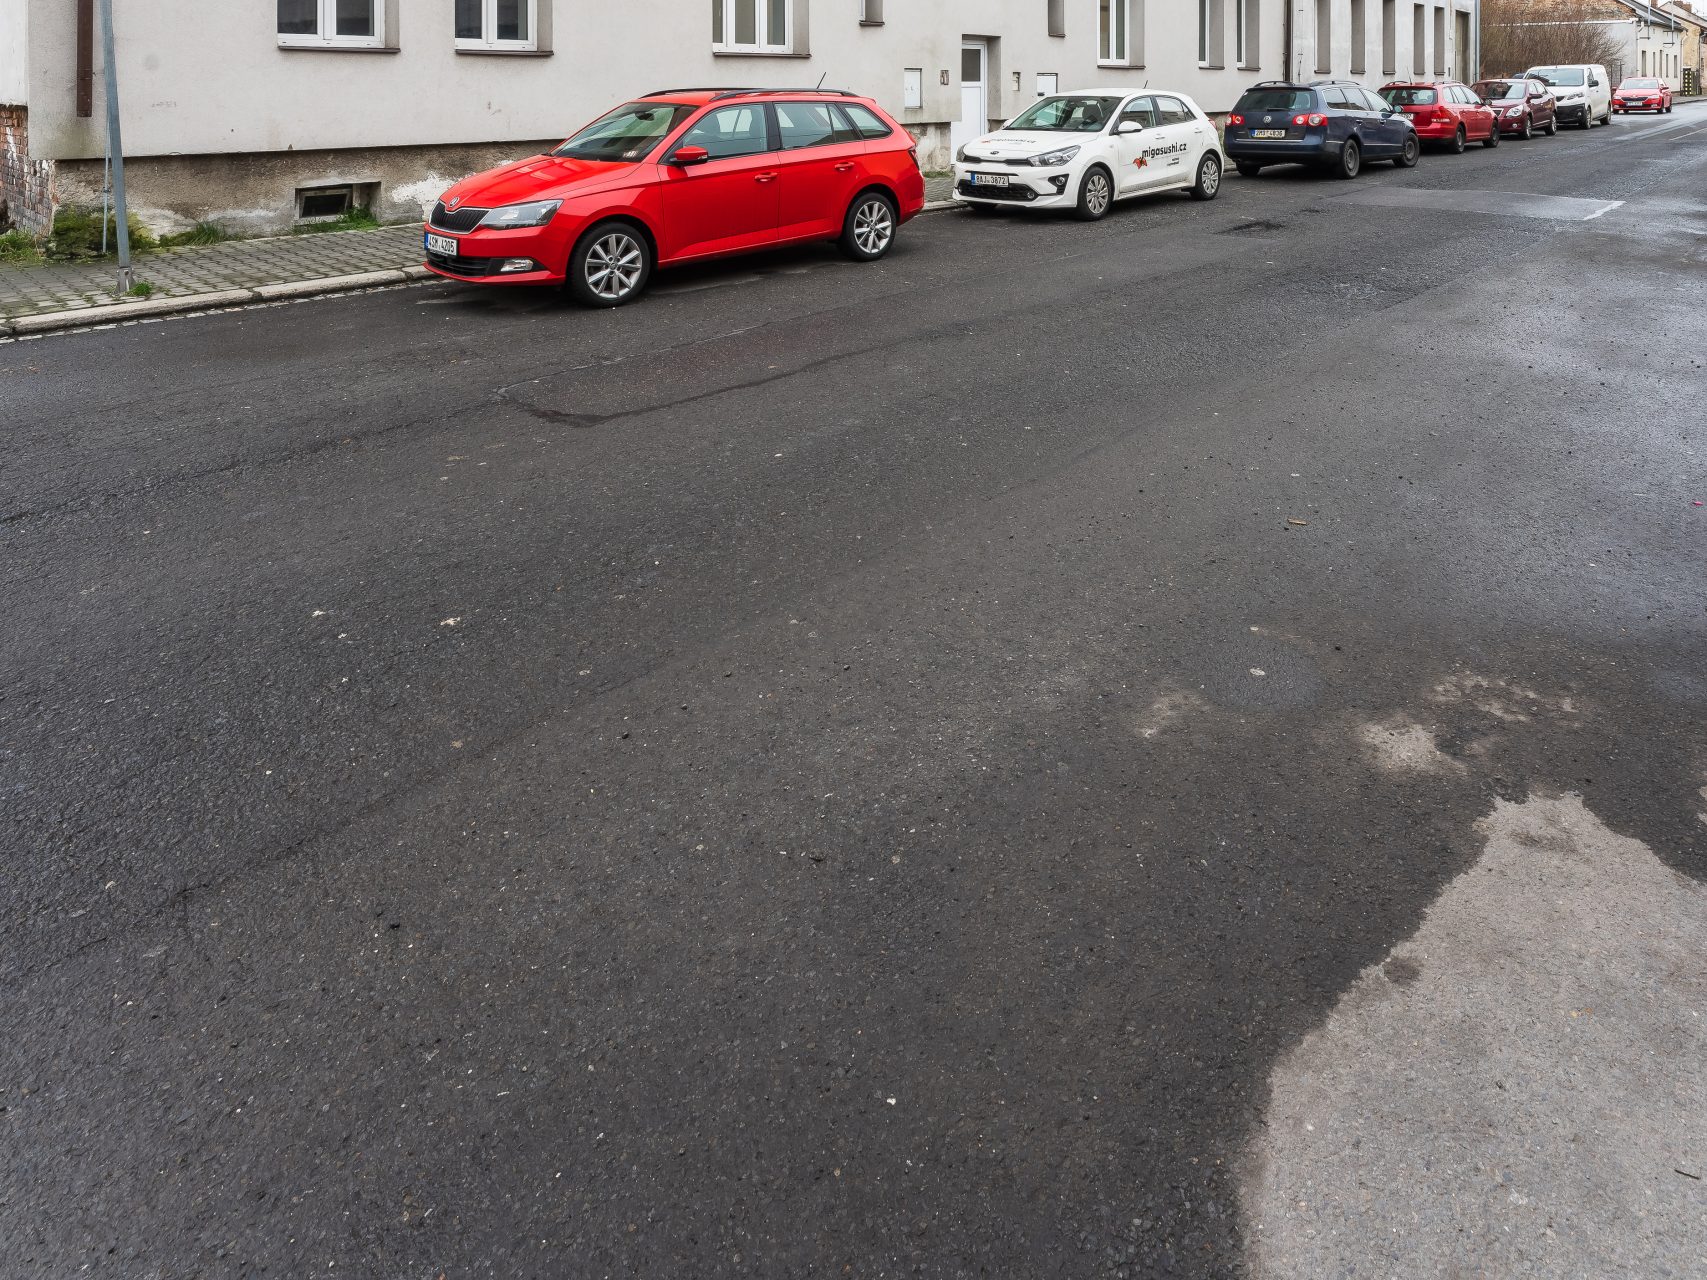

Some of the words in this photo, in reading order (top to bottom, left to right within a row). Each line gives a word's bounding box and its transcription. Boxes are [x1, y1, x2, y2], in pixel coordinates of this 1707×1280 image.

[1142, 142, 1187, 159] migasushi.cz
[990, 176, 1006, 185] 3872
[441, 238, 455, 253] 4205
